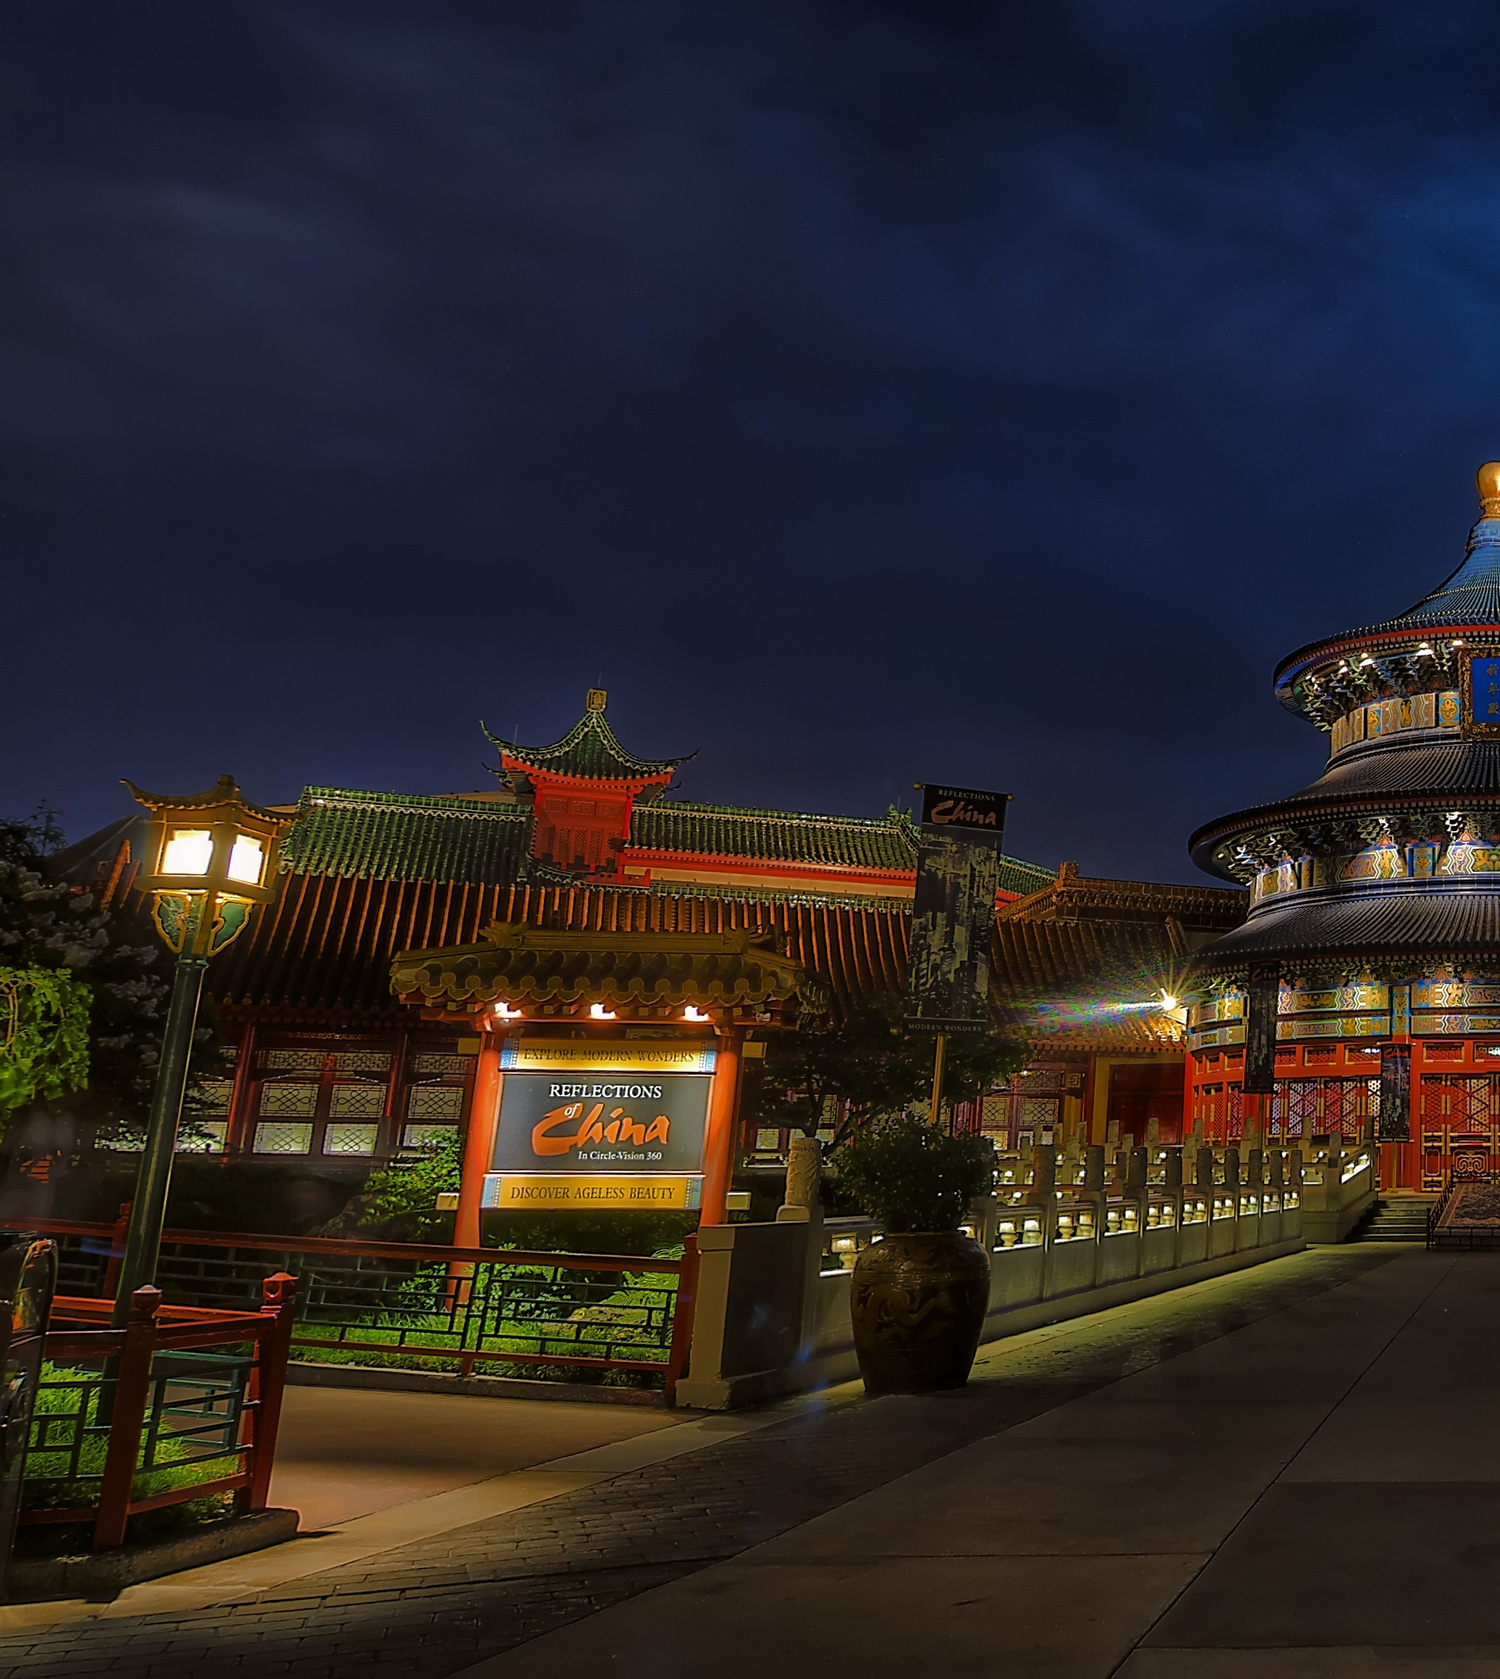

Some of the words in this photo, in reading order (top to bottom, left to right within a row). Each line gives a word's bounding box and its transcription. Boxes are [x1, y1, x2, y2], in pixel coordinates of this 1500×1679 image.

[938, 789, 995, 801] REFLECTIONS
[931, 800, 997, 826] China
[523, 1048, 577, 1061] EXPLORE
[581, 1049, 633, 1062] MODERN
[638, 1050, 695, 1063] WONDERS
[549, 1084, 662, 1099] REFLECTIONS
[564, 1103, 581, 1118] of
[531, 1102, 671, 1157] China
[578, 1151, 588, 1160] In
[589, 1151, 645, 1160] Circle-Vision
[646, 1151, 662, 1160] 360
[510, 1187, 570, 1199] DISCOVER
[574, 1187, 625, 1199] AGELESS
[629, 1187, 676, 1200] BEAUTY
